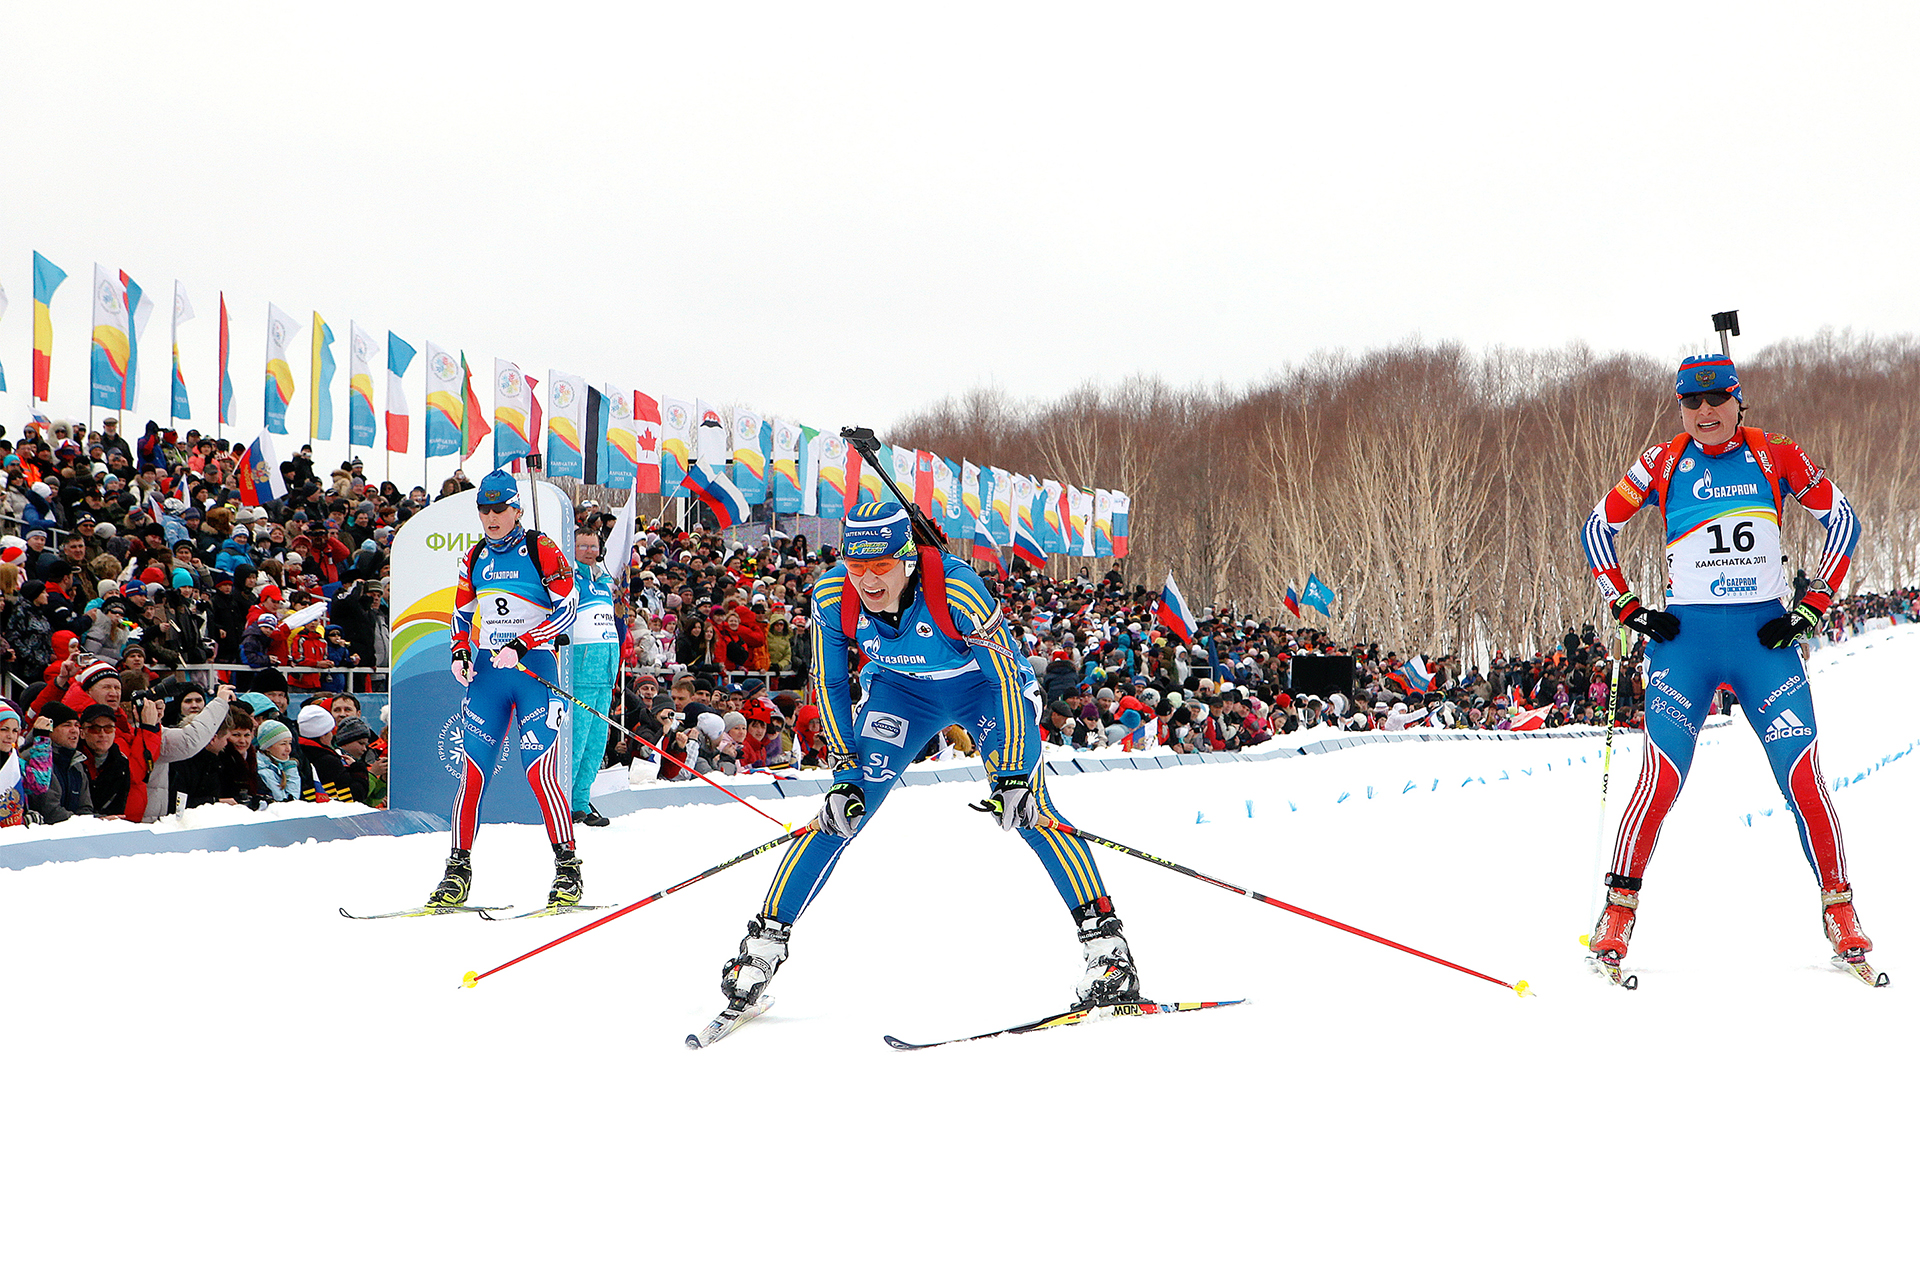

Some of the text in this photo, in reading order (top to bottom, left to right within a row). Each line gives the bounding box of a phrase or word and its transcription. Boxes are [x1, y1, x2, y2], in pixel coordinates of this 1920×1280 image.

[1714, 483, 1759, 497] GAZPROM
[1706, 522, 1755, 554] 16
[1695, 555, 1767, 568] KAMCHATKA 2011
[1726, 577, 1757, 586] GAZPROM
[495, 597, 510, 616] 8
[879, 655, 926, 664] ГАЗПРОМ
[1657, 681, 1693, 710] GAZPROM
[1757, 675, 1801, 714] Webasto
[438, 713, 461, 739] ПАМЯТИ
[873, 723, 899, 733] VOLVO
[1764, 726, 1813, 743] adidas
[437, 740, 446, 761] ПРИЗ
[868, 752, 889, 769] SJ
[444, 763, 461, 780] КУБО
[1093, 837, 1131, 854] LEKI
